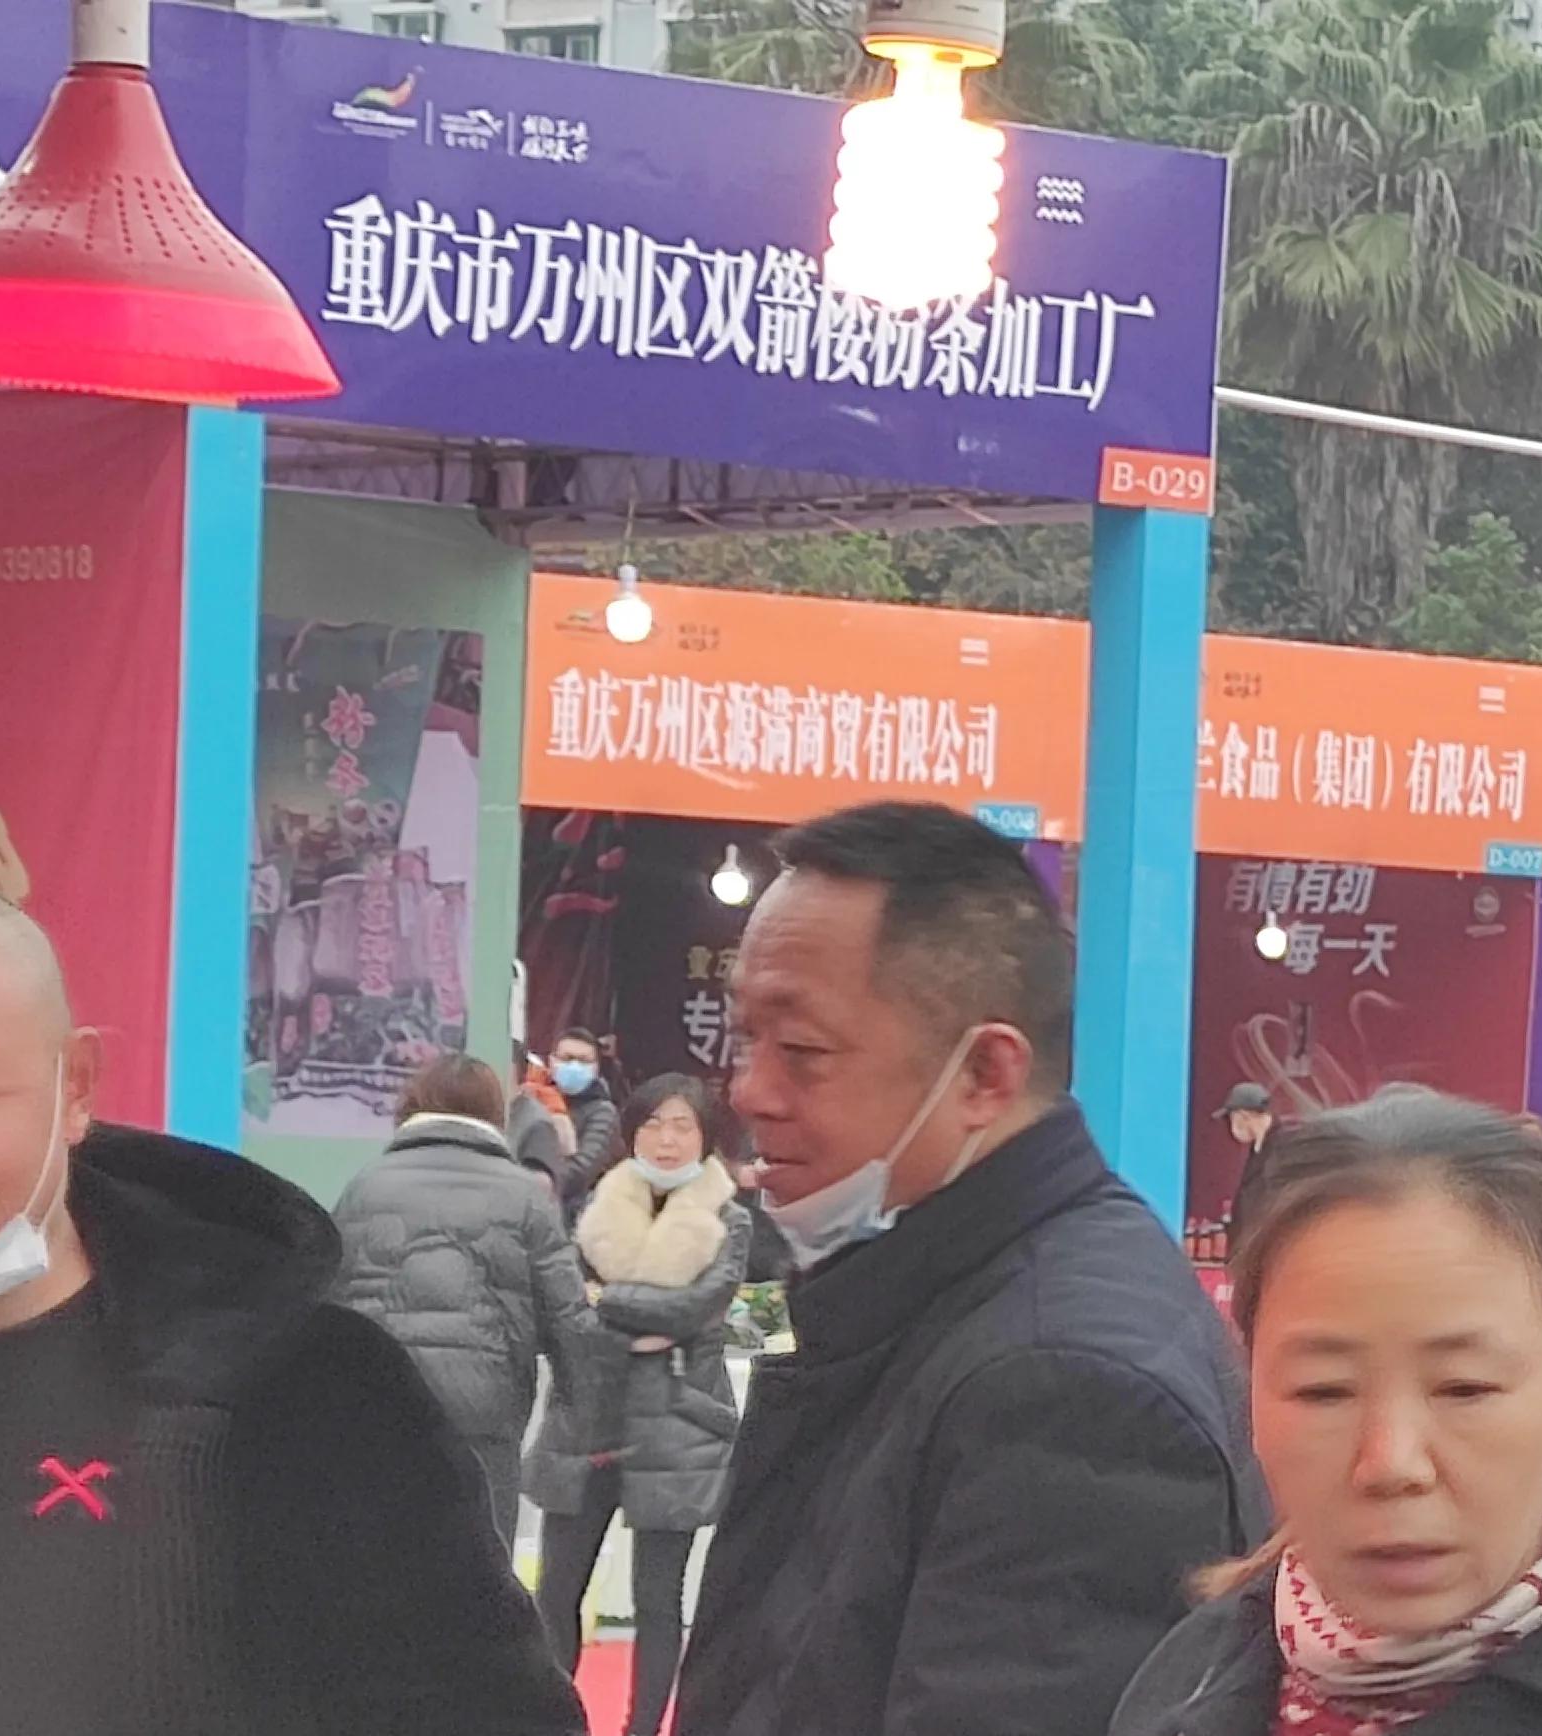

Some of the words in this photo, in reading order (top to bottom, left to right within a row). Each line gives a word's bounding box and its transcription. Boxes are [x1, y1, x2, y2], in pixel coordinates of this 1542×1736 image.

[1111, 461, 1205, 500] B-029
[1284, 921, 1398, 977] 每一天
